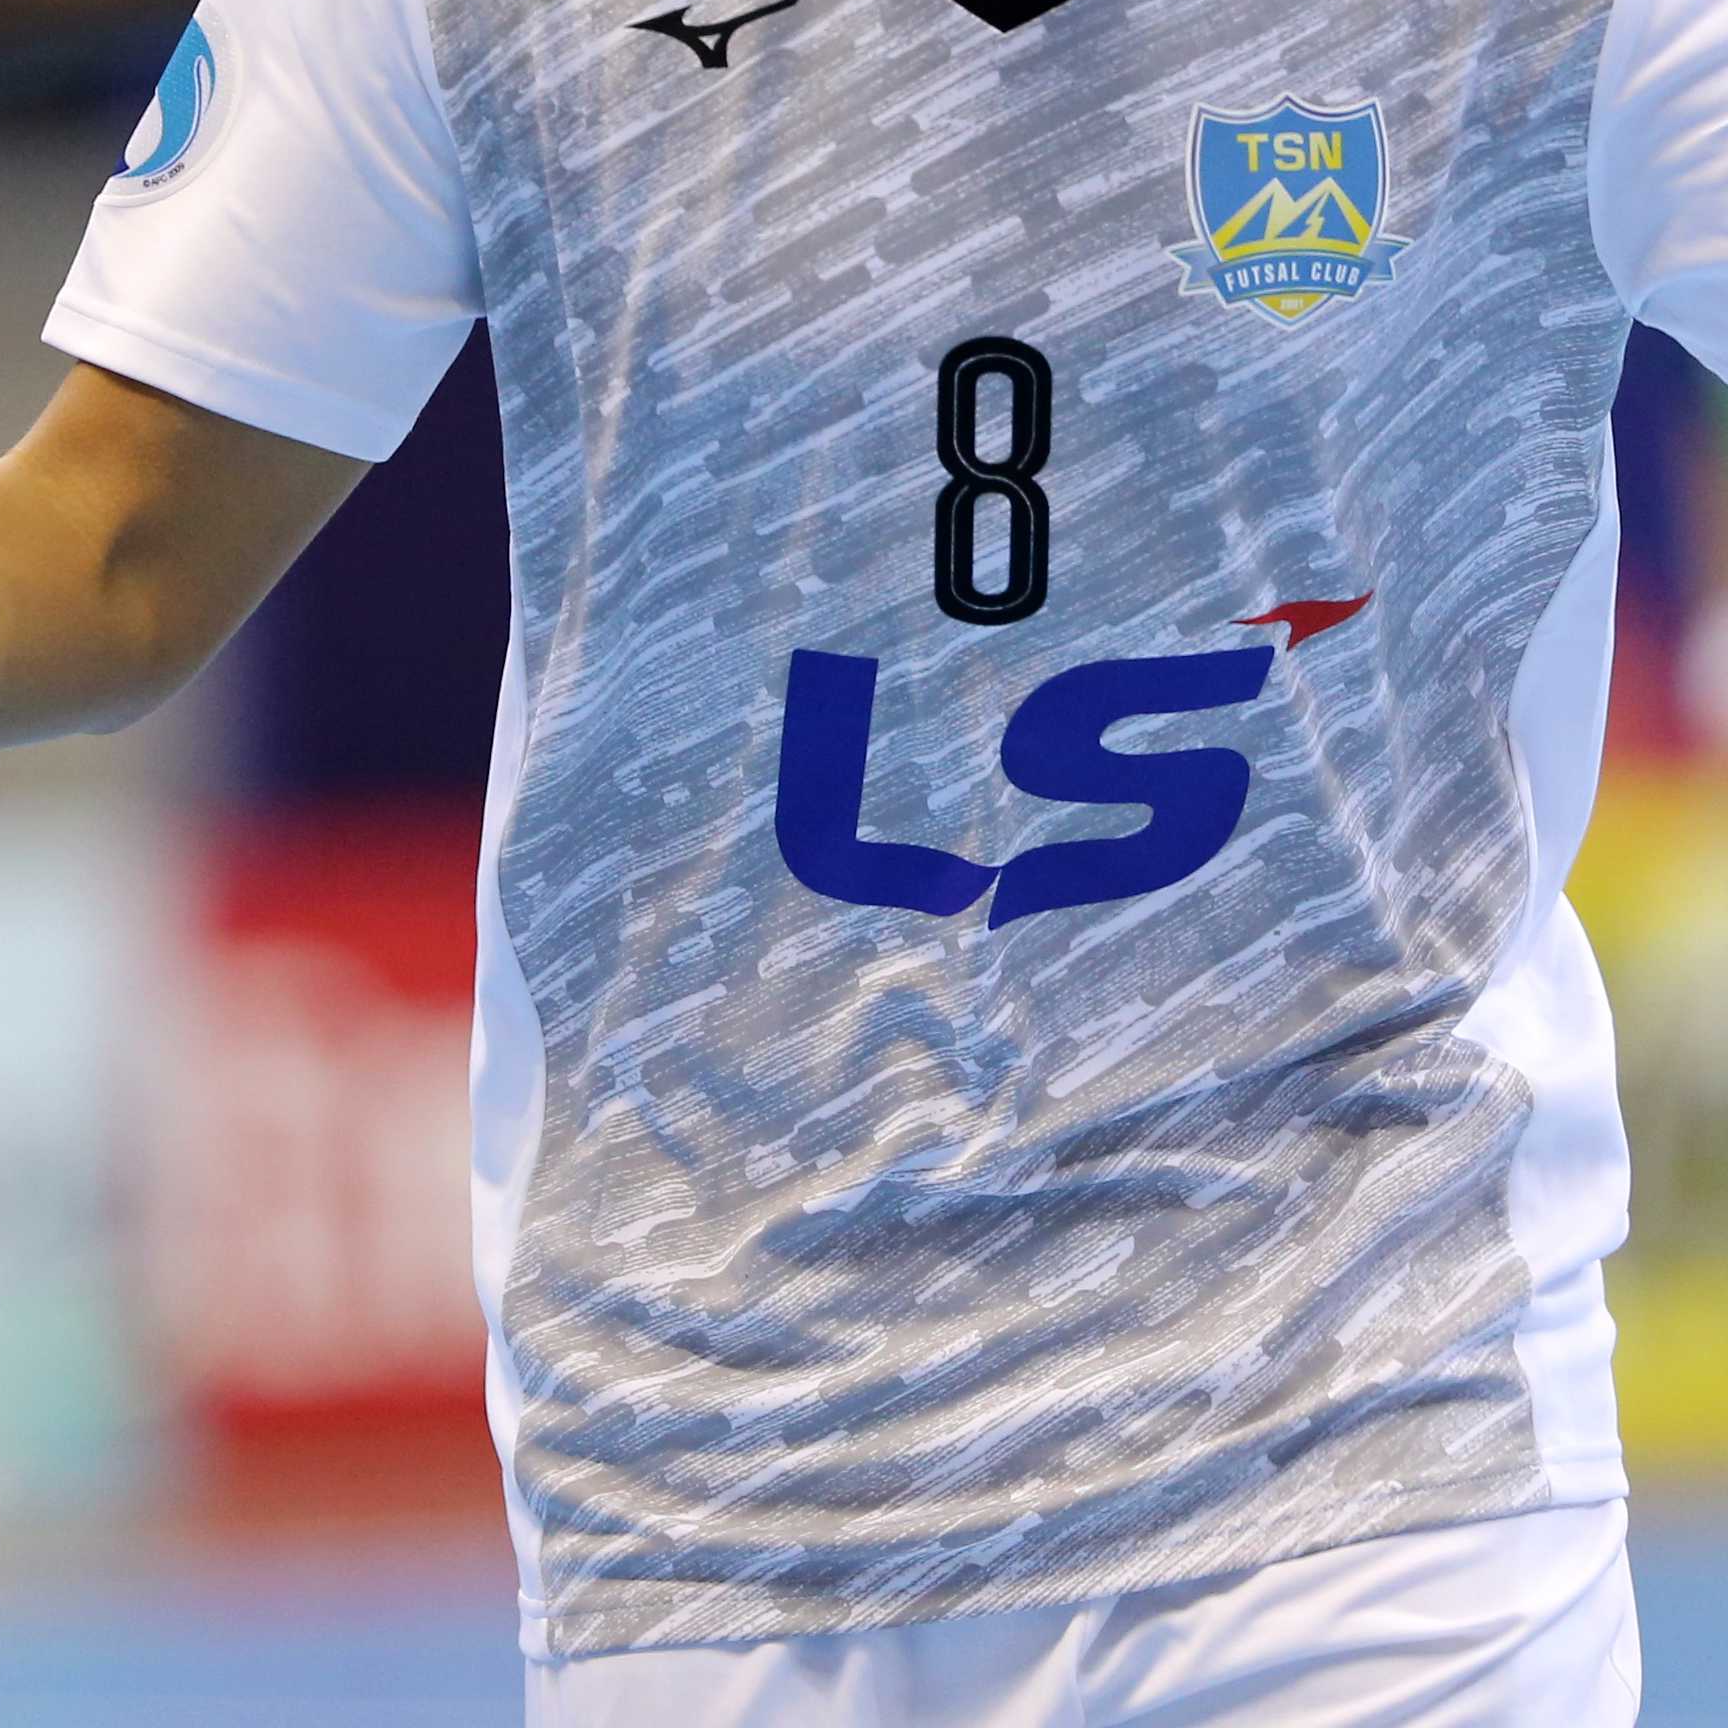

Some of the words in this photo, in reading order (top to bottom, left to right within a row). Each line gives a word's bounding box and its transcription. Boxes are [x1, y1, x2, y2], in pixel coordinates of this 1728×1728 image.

[1236, 131, 1344, 172] TSN
[1224, 261, 1300, 293] FUTSAL
[1310, 261, 1361, 286] CLUB
[934, 335, 1053, 626] 8
[774, 646, 1275, 930] LS
